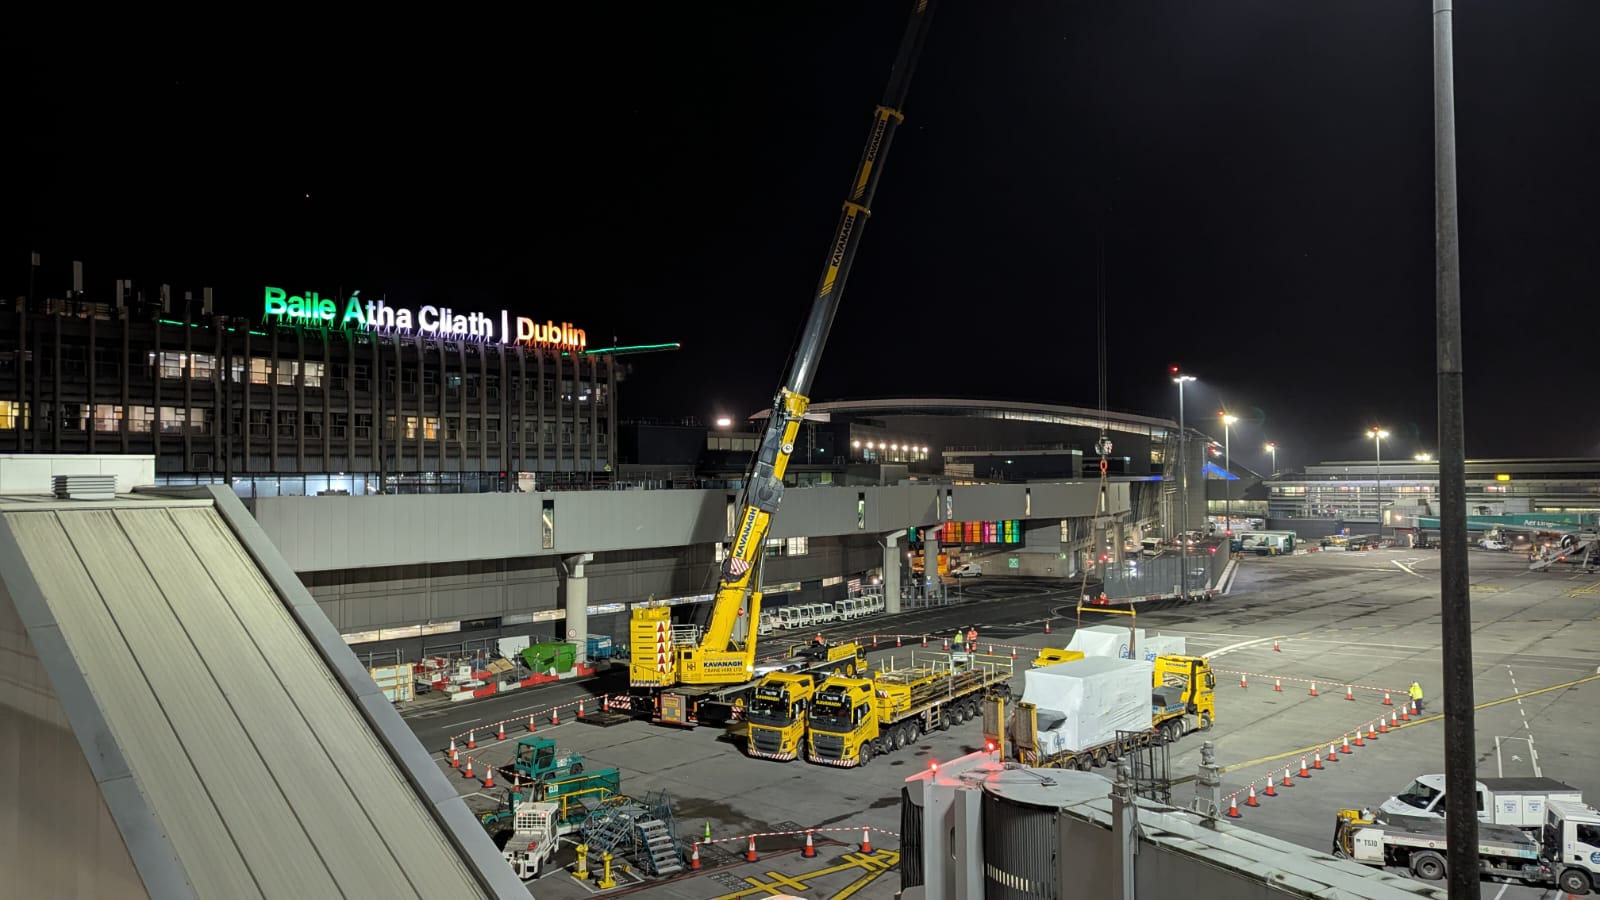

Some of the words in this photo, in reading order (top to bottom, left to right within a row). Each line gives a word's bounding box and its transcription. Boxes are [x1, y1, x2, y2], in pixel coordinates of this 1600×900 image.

[867, 119, 886, 162] KAVANAGH
[831, 215, 854, 267] KAVANAGH
[265, 286, 336, 320] Baile
[343, 290, 412, 328] Átha
[418, 305, 493, 337] Cliath
[517, 316, 586, 346] Dublin
[735, 508, 757, 558] KAVANAGH
[703, 660, 743, 668] KAVANAGH
